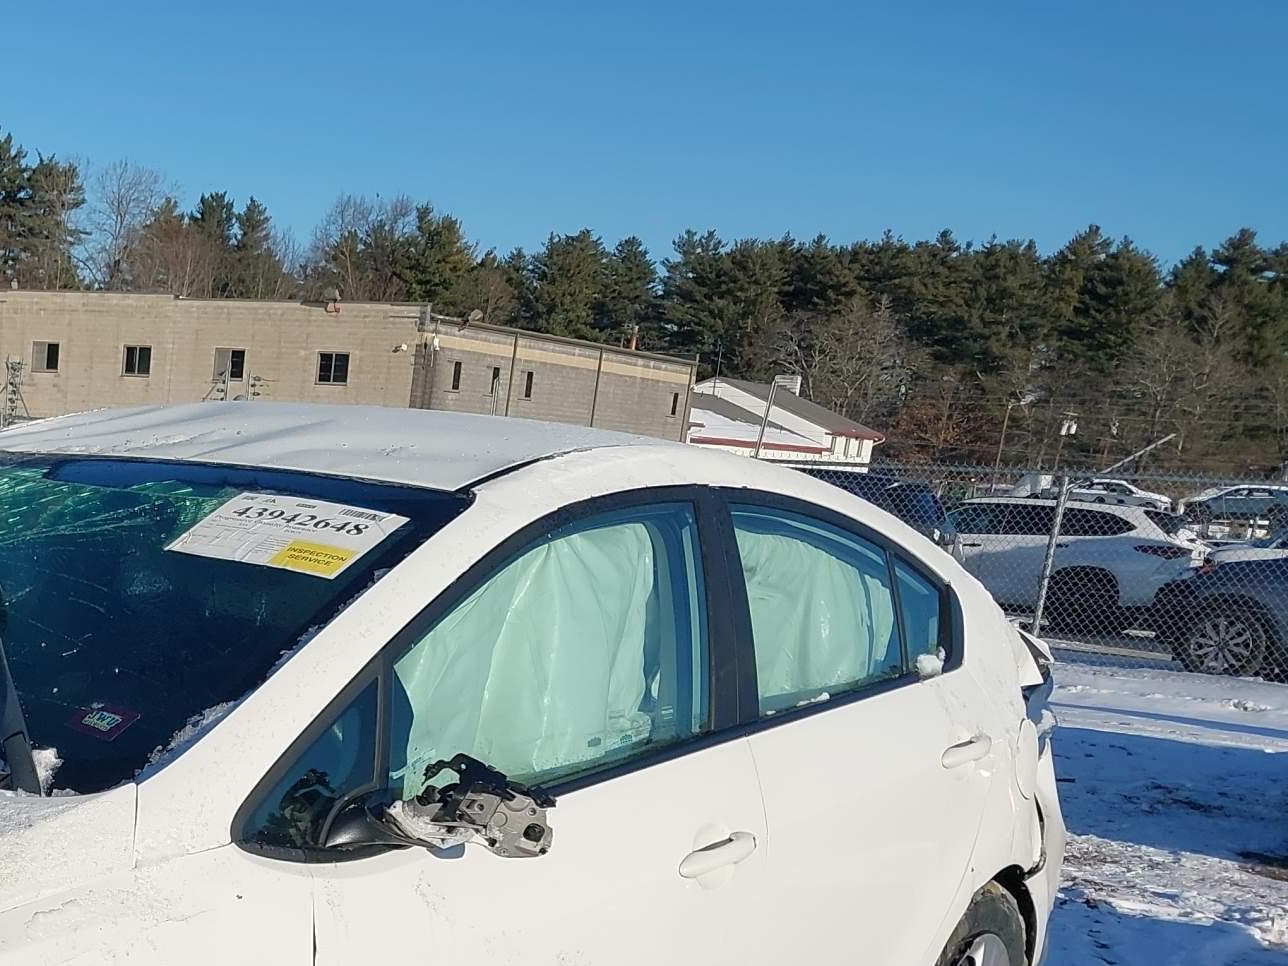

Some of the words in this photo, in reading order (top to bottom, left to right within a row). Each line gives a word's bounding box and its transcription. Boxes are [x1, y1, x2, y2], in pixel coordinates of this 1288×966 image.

[232, 506, 369, 536] 43942648
[287, 546, 348, 562] INSPECTION
[287, 553, 335, 567] SERVICE
